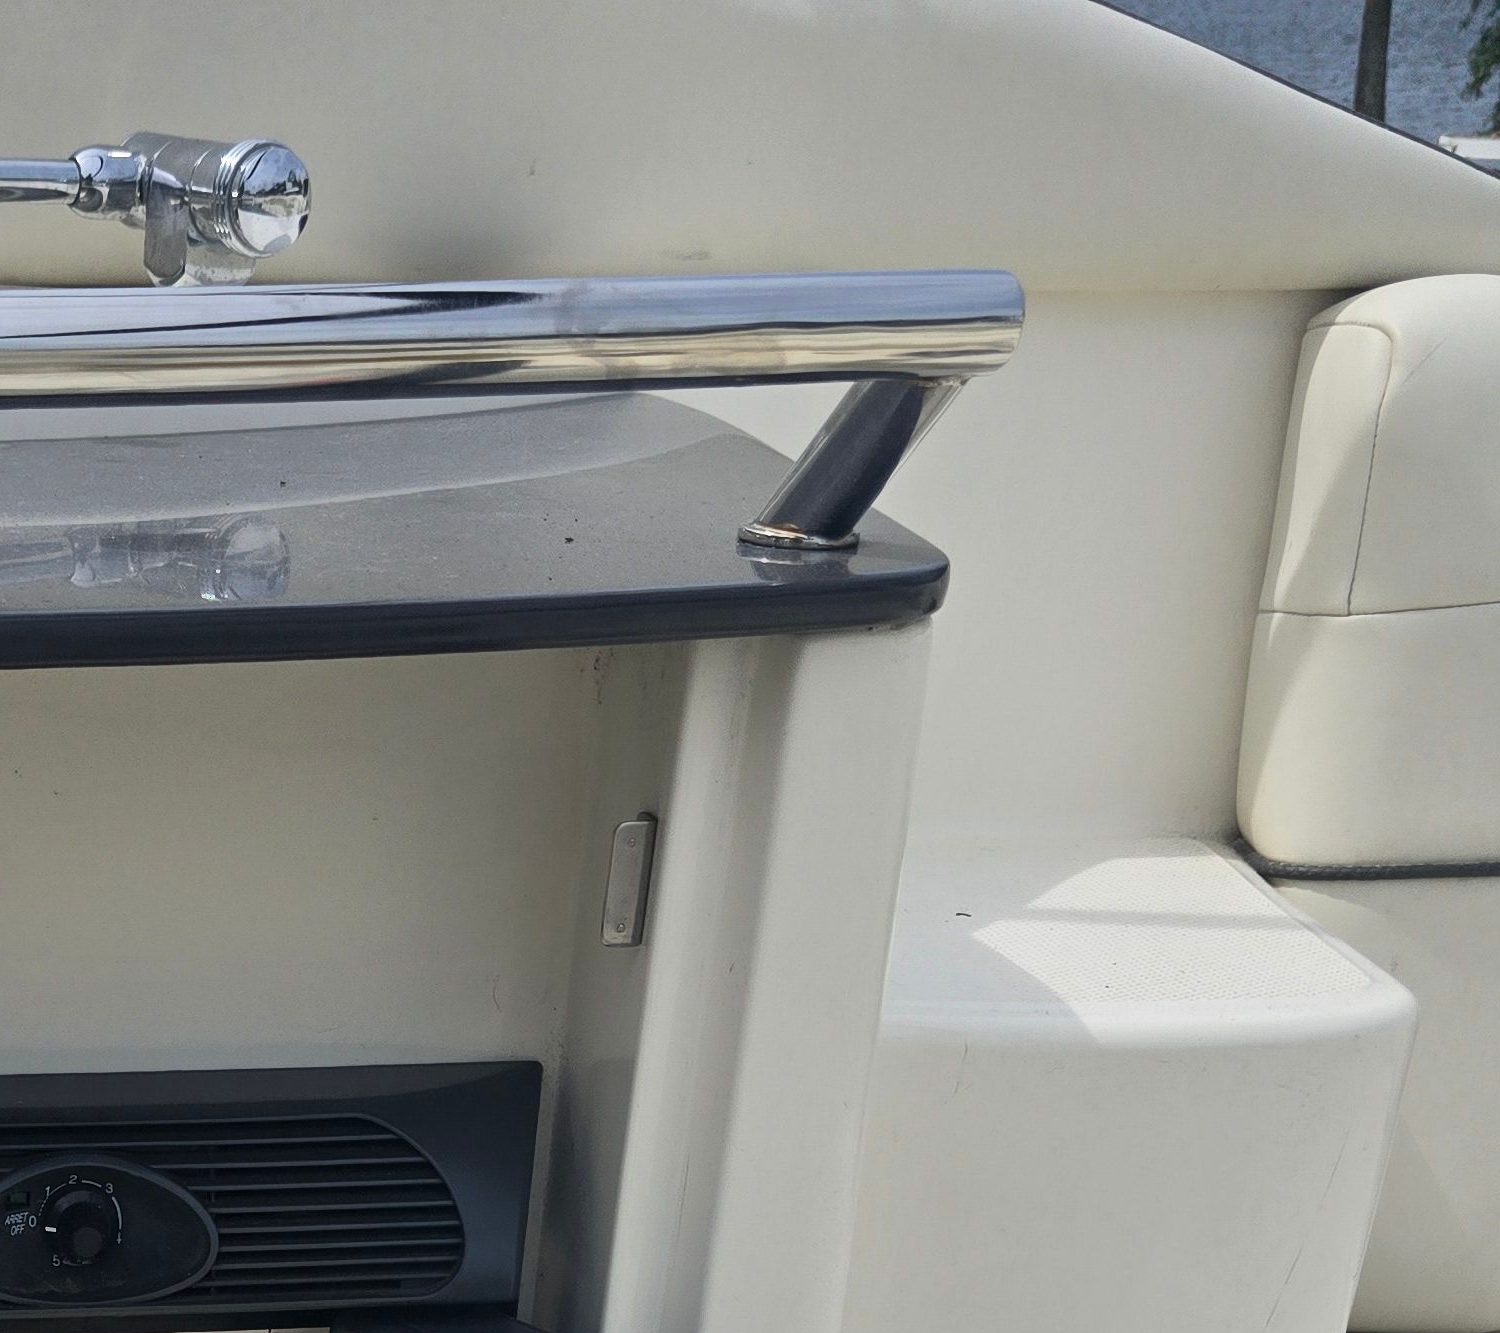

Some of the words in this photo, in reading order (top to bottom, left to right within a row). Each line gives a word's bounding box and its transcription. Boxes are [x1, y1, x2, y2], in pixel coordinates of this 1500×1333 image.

[68, 1174, 78, 1185] 2
[105, 1182, 114, 1194] 3
[10, 1223, 26, 1236] OFF
[52, 1254, 61, 1267] 5
